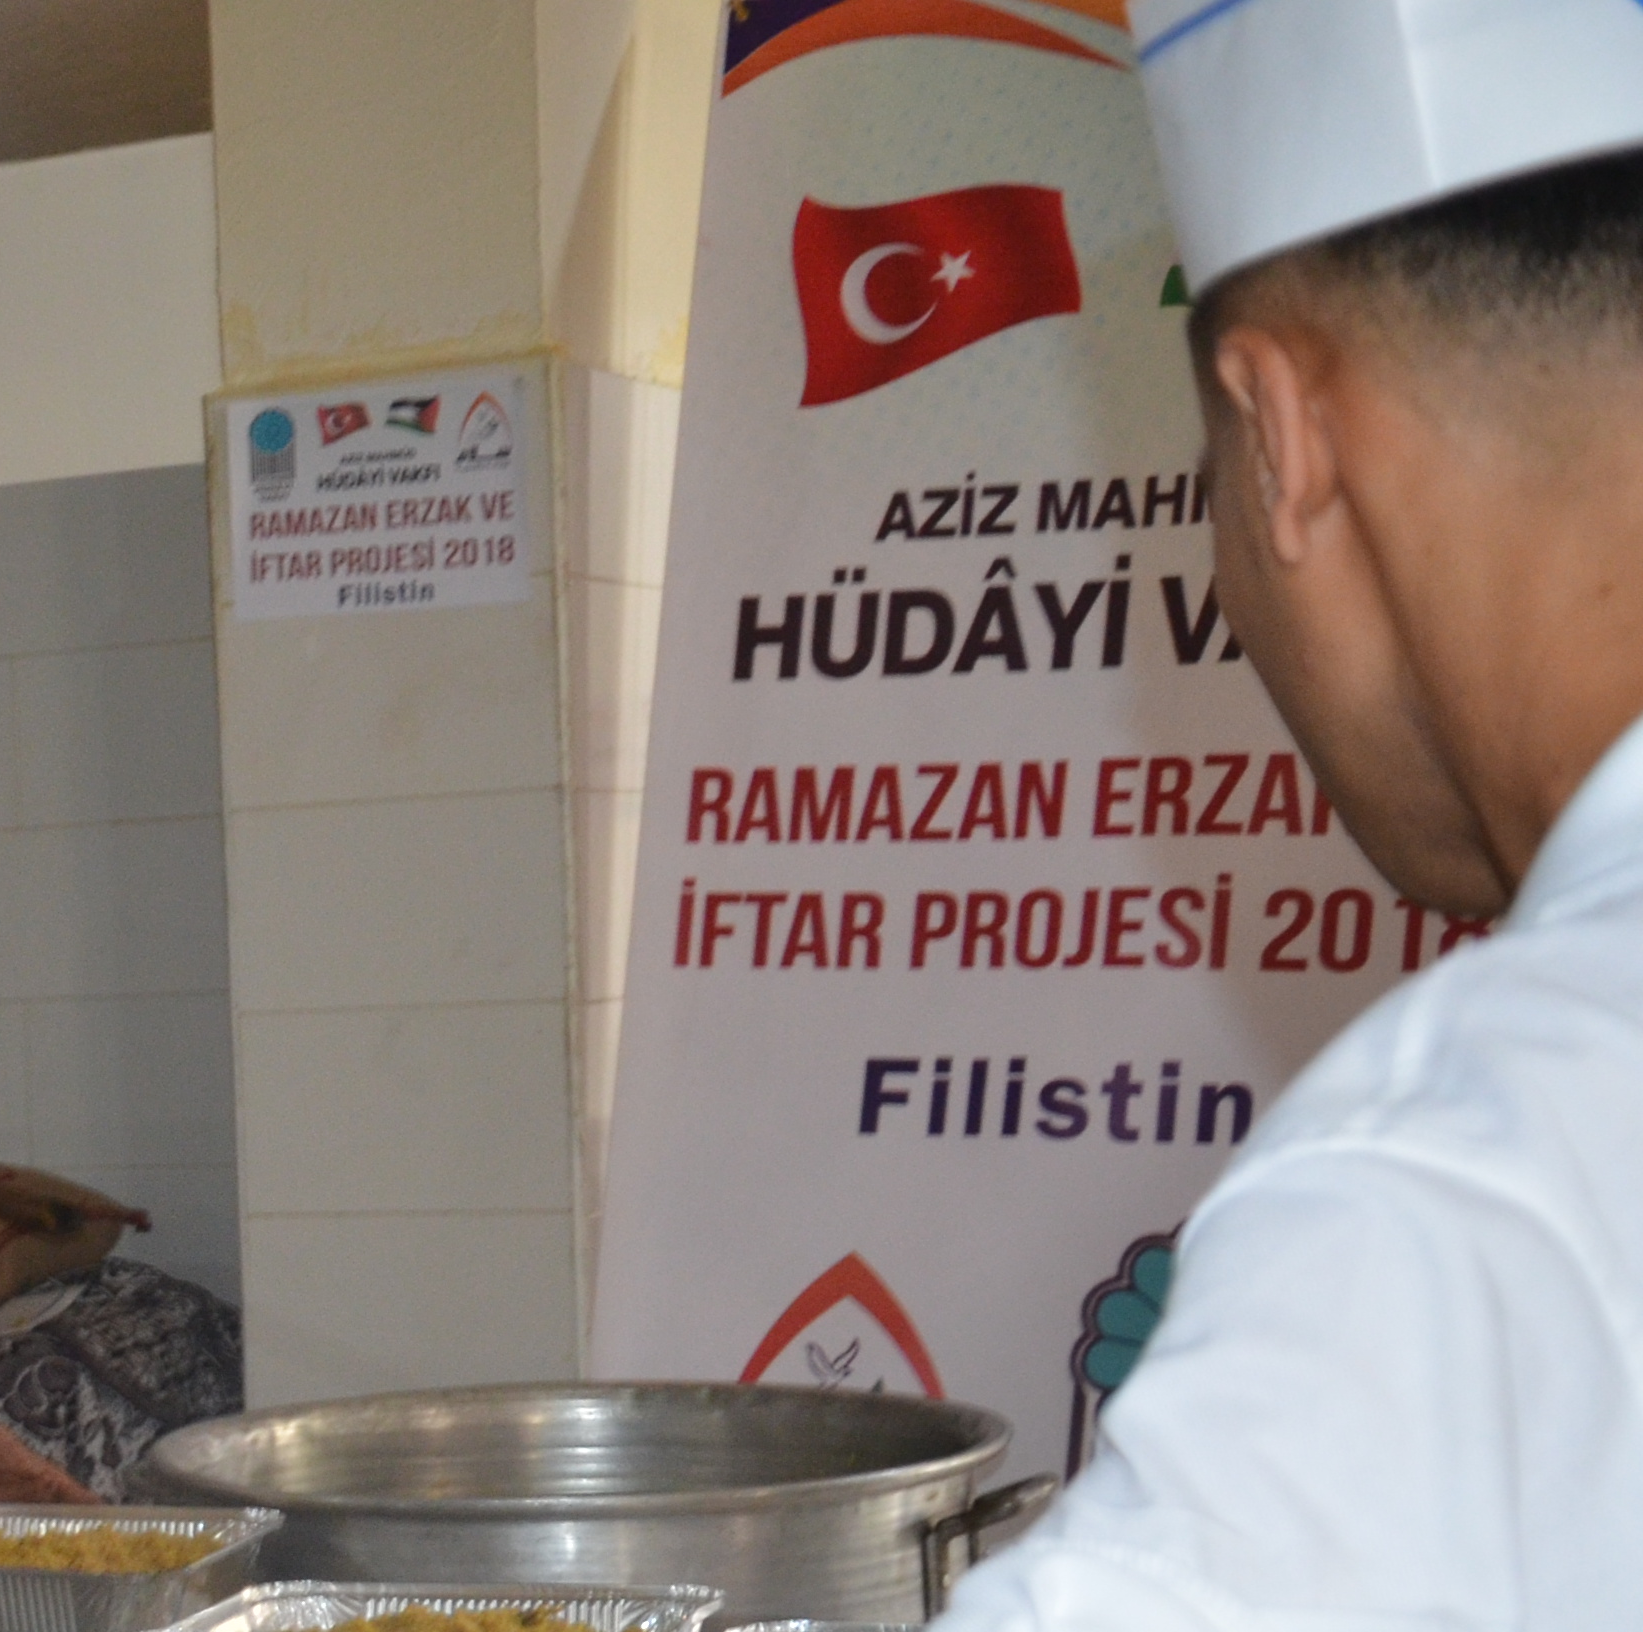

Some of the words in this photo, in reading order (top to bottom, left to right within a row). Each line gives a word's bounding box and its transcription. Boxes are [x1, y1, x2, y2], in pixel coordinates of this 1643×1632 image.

[249, 500, 377, 542] RAMAZAN
[386, 494, 473, 533] ERZAK
[481, 489, 516, 522] VE
[874, 473, 1020, 542] AZİZ
[445, 535, 516, 570] 2018
[337, 580, 436, 609] Filistin
[732, 554, 1131, 681] HÜDÂYİ
[685, 758, 1069, 845] RAMAZAN
[672, 878, 886, 970] İFTAR
[909, 871, 1233, 971] PROJESİ
[857, 1057, 1256, 1146] Filistin
